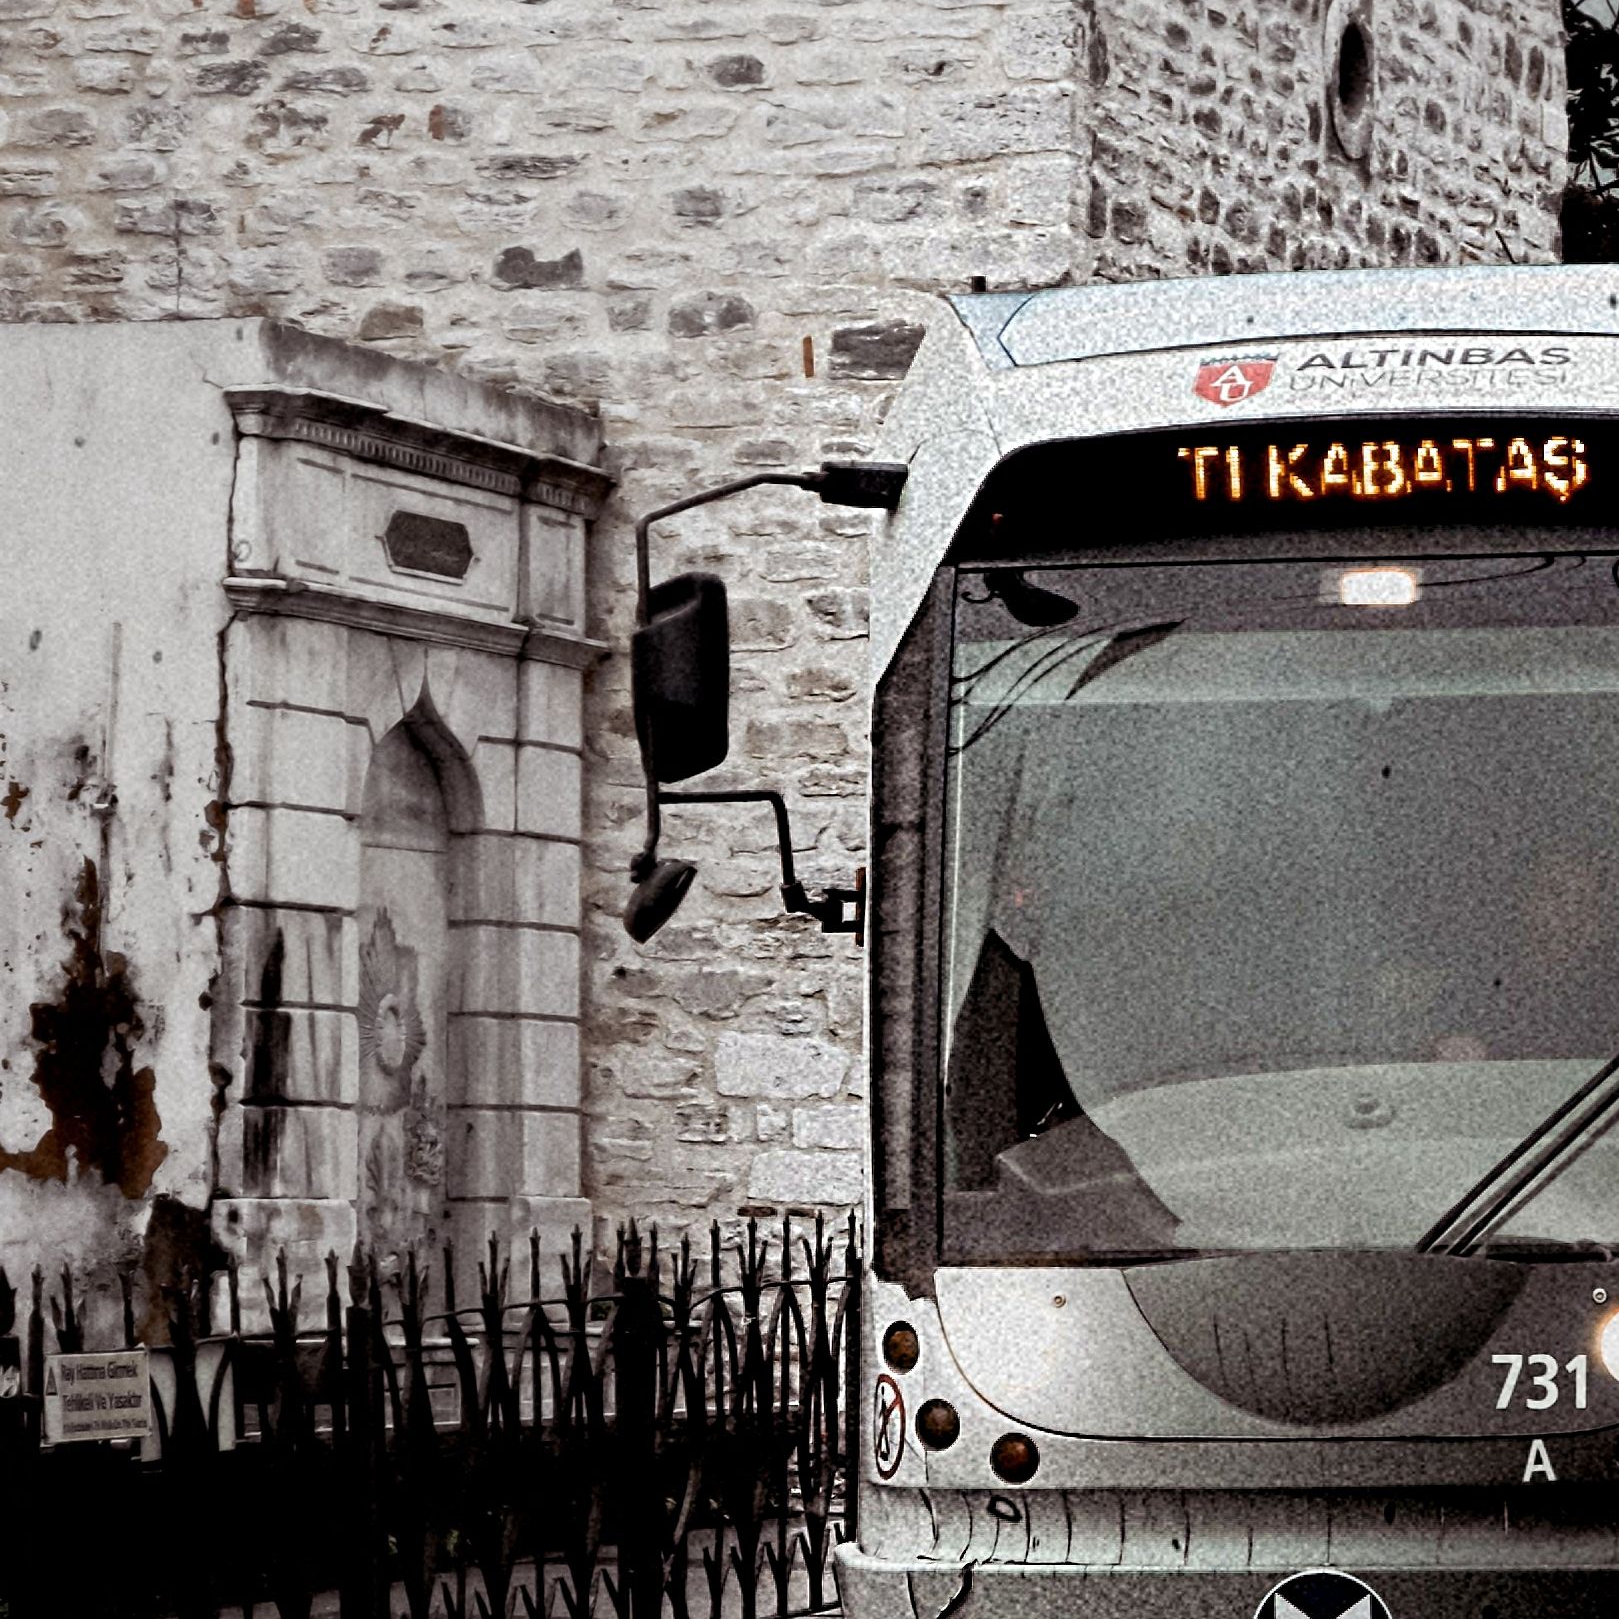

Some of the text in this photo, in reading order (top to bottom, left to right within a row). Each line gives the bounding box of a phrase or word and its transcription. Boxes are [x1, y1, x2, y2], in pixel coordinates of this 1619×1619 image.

[1267, 436, 1585, 503] KABATAŞ
[1491, 1354, 1588, 1410] 731
[1522, 1439, 1557, 1482] A
